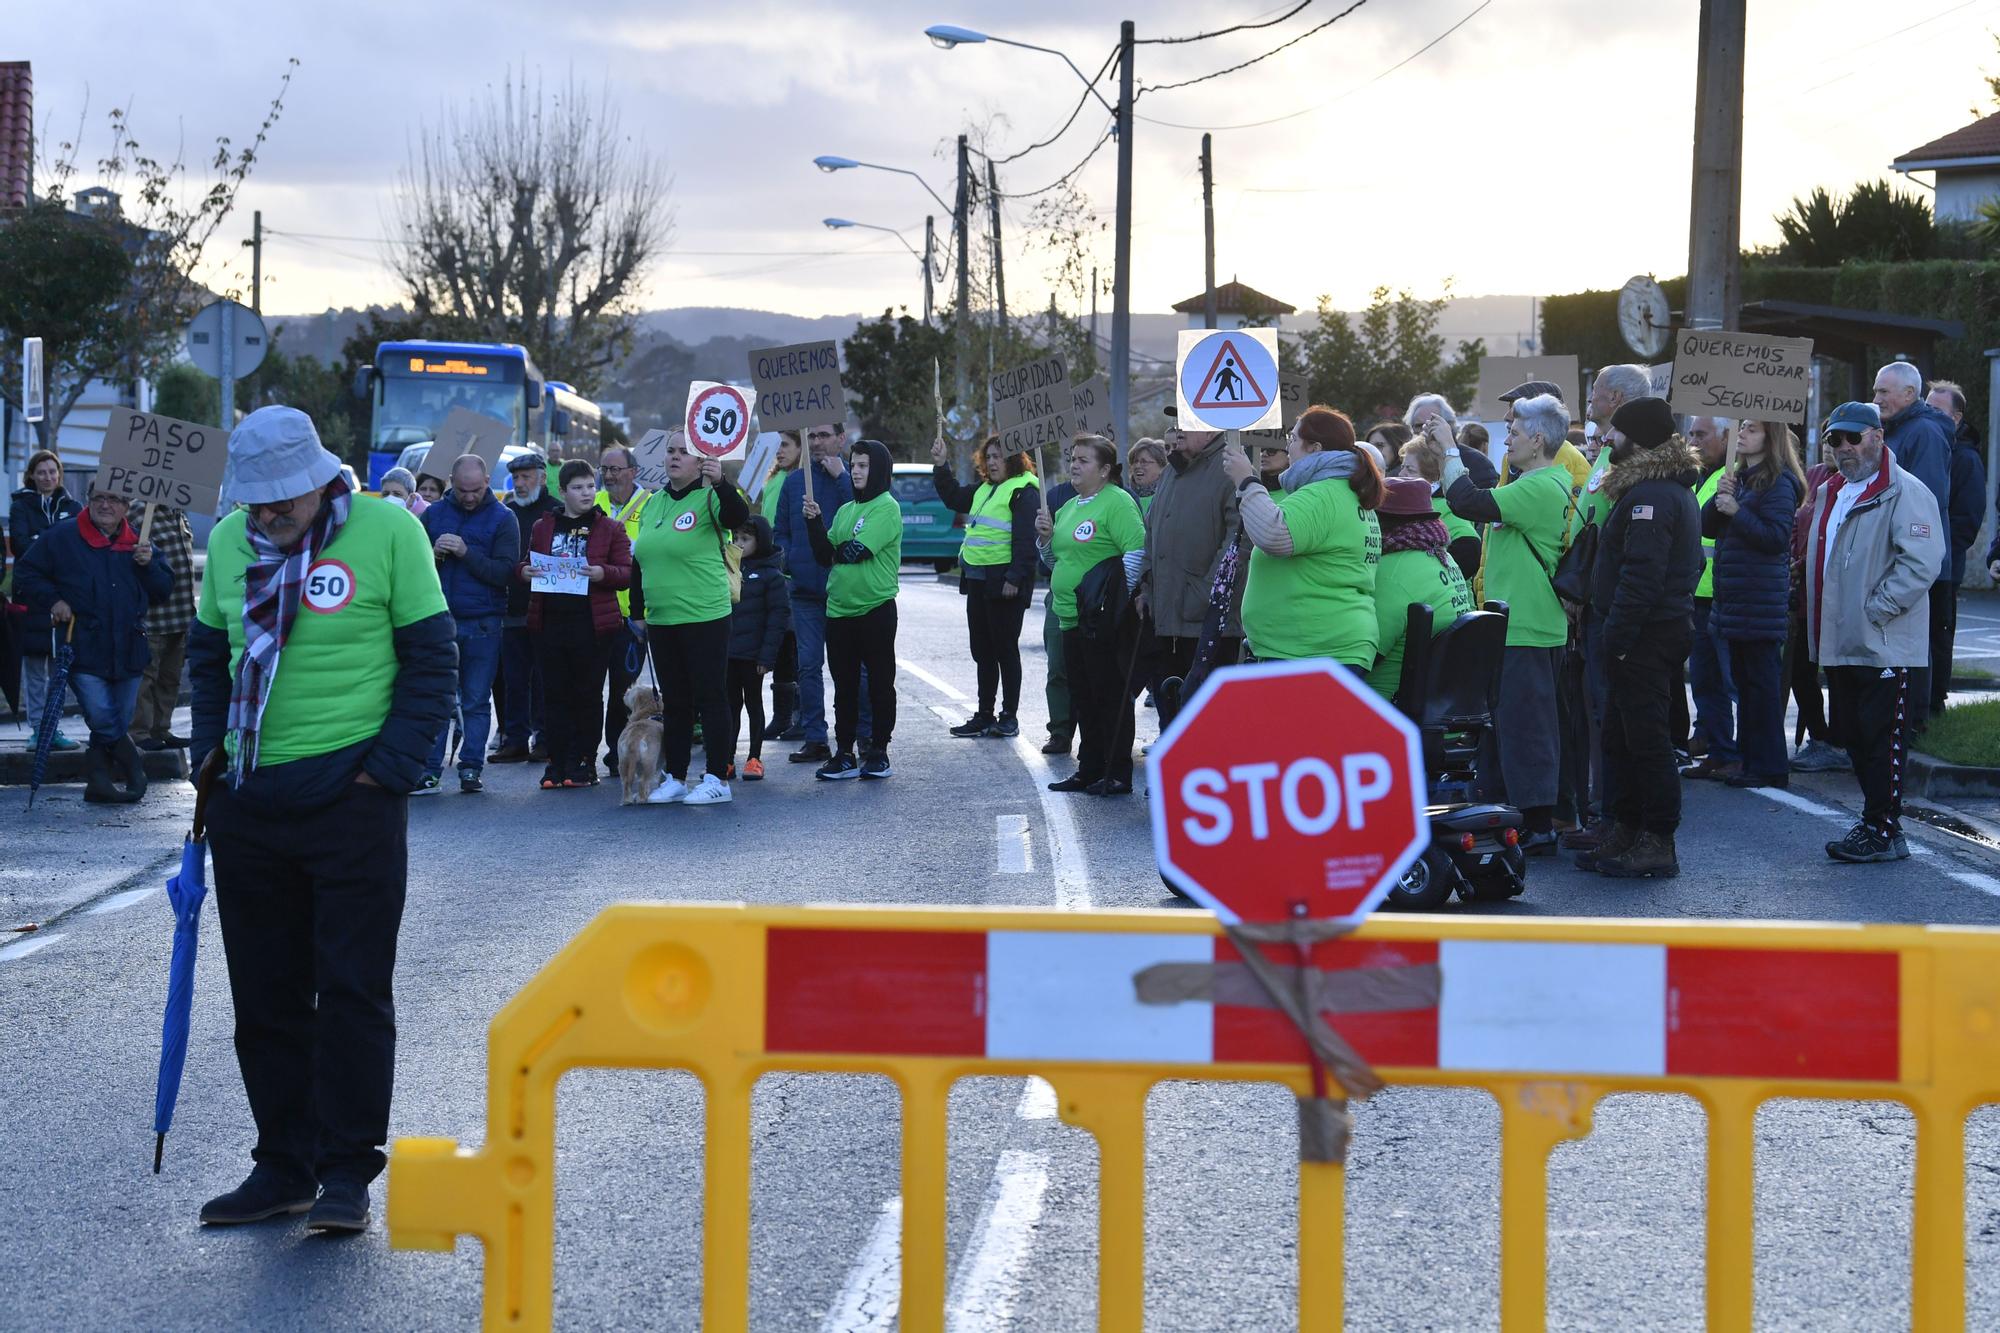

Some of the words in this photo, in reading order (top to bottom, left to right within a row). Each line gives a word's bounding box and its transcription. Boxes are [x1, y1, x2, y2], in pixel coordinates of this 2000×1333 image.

[758, 347, 837, 380] QUEREMOS
[1683, 336, 1785, 363] QUEREMOS
[992, 359, 1063, 402] SEGURIDAD
[1680, 371, 1708, 386] CON
[1743, 362, 1804, 380] CRUZAR
[761, 384, 834, 417] CRUZAR
[1018, 392, 1054, 422] PARA
[128, 415, 205, 454] PASO
[702, 406, 737, 437] 50
[1004, 415, 1069, 453] CRUZAR
[141, 447, 176, 471] DE
[107, 467, 192, 506] PEONS
[677, 515, 692, 525] 50
[1077, 525, 1091, 535] 50
[309, 576, 345, 597] 50
[1181, 752, 1393, 846] STOP
